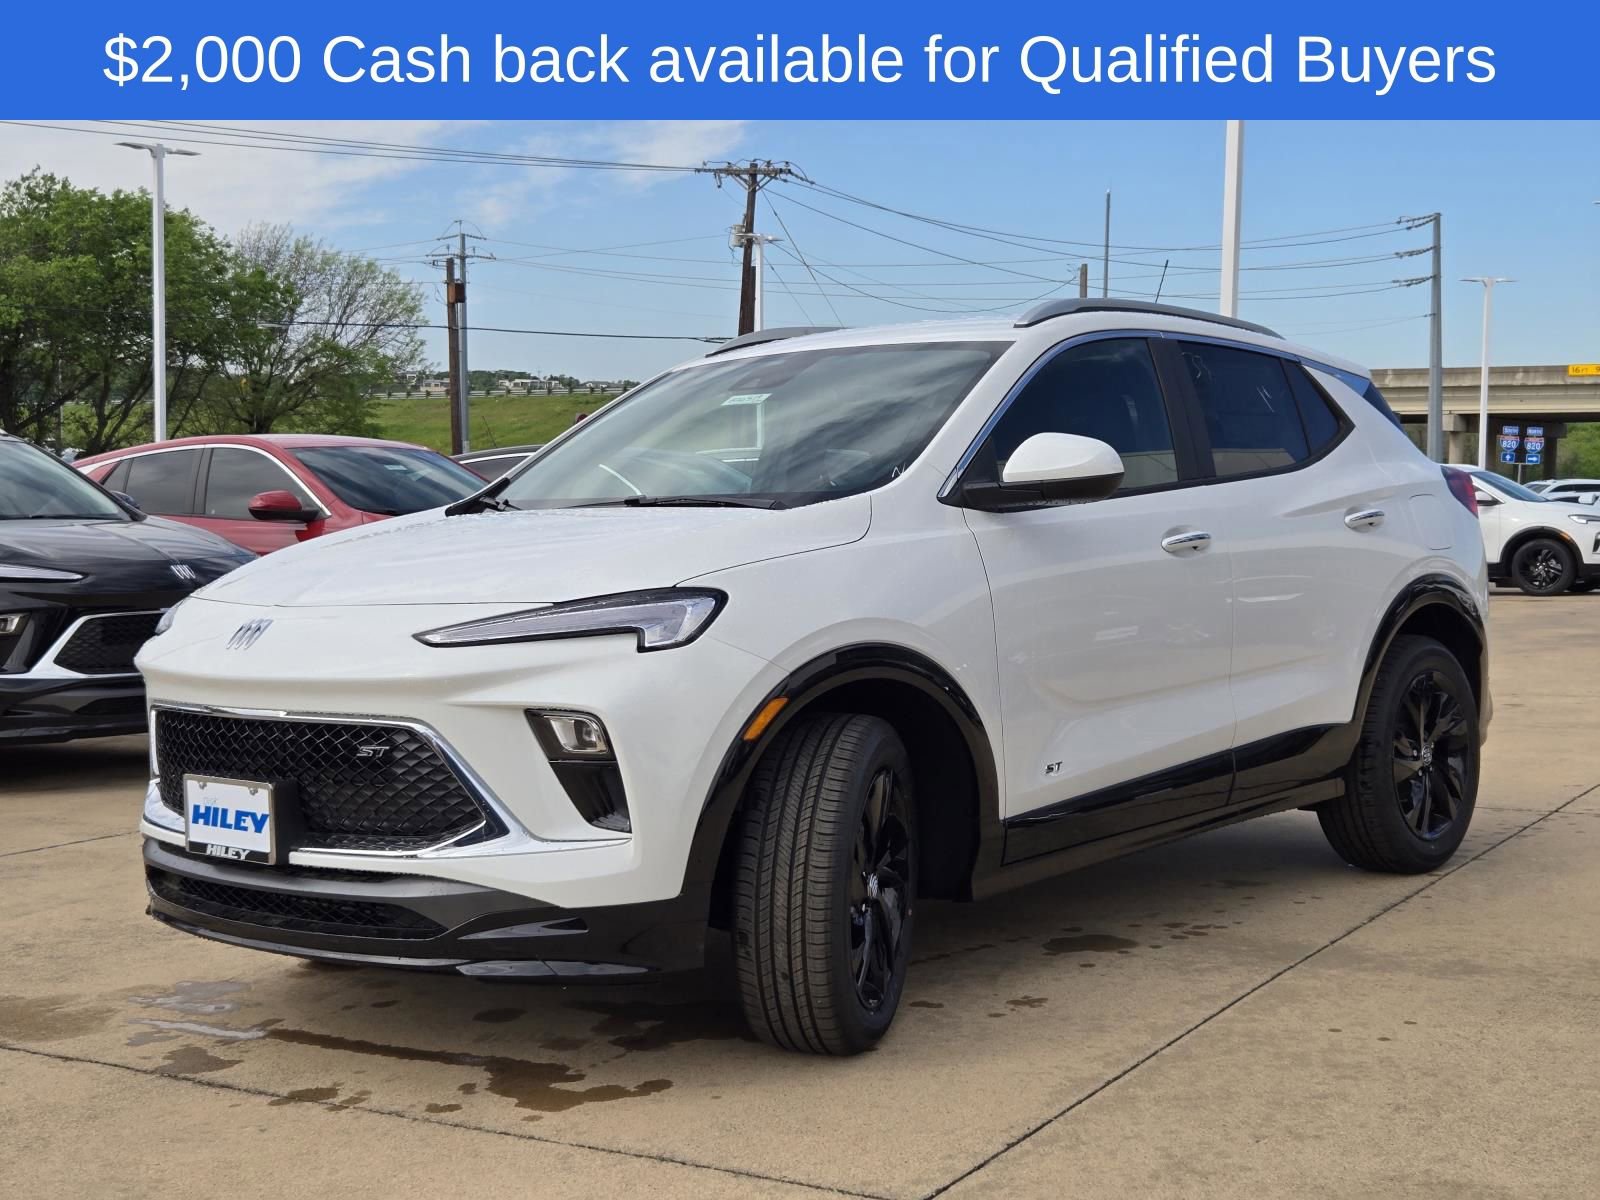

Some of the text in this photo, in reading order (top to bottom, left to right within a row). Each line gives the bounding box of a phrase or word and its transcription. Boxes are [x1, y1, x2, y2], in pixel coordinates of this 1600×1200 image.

[1502, 440, 1517, 448] 820
[1526, 442, 1541, 450] 820
[356, 745, 390, 758] ST
[1045, 761, 1063, 774] ST
[191, 804, 270, 834] HILEY
[206, 844, 251, 861] HILEY
